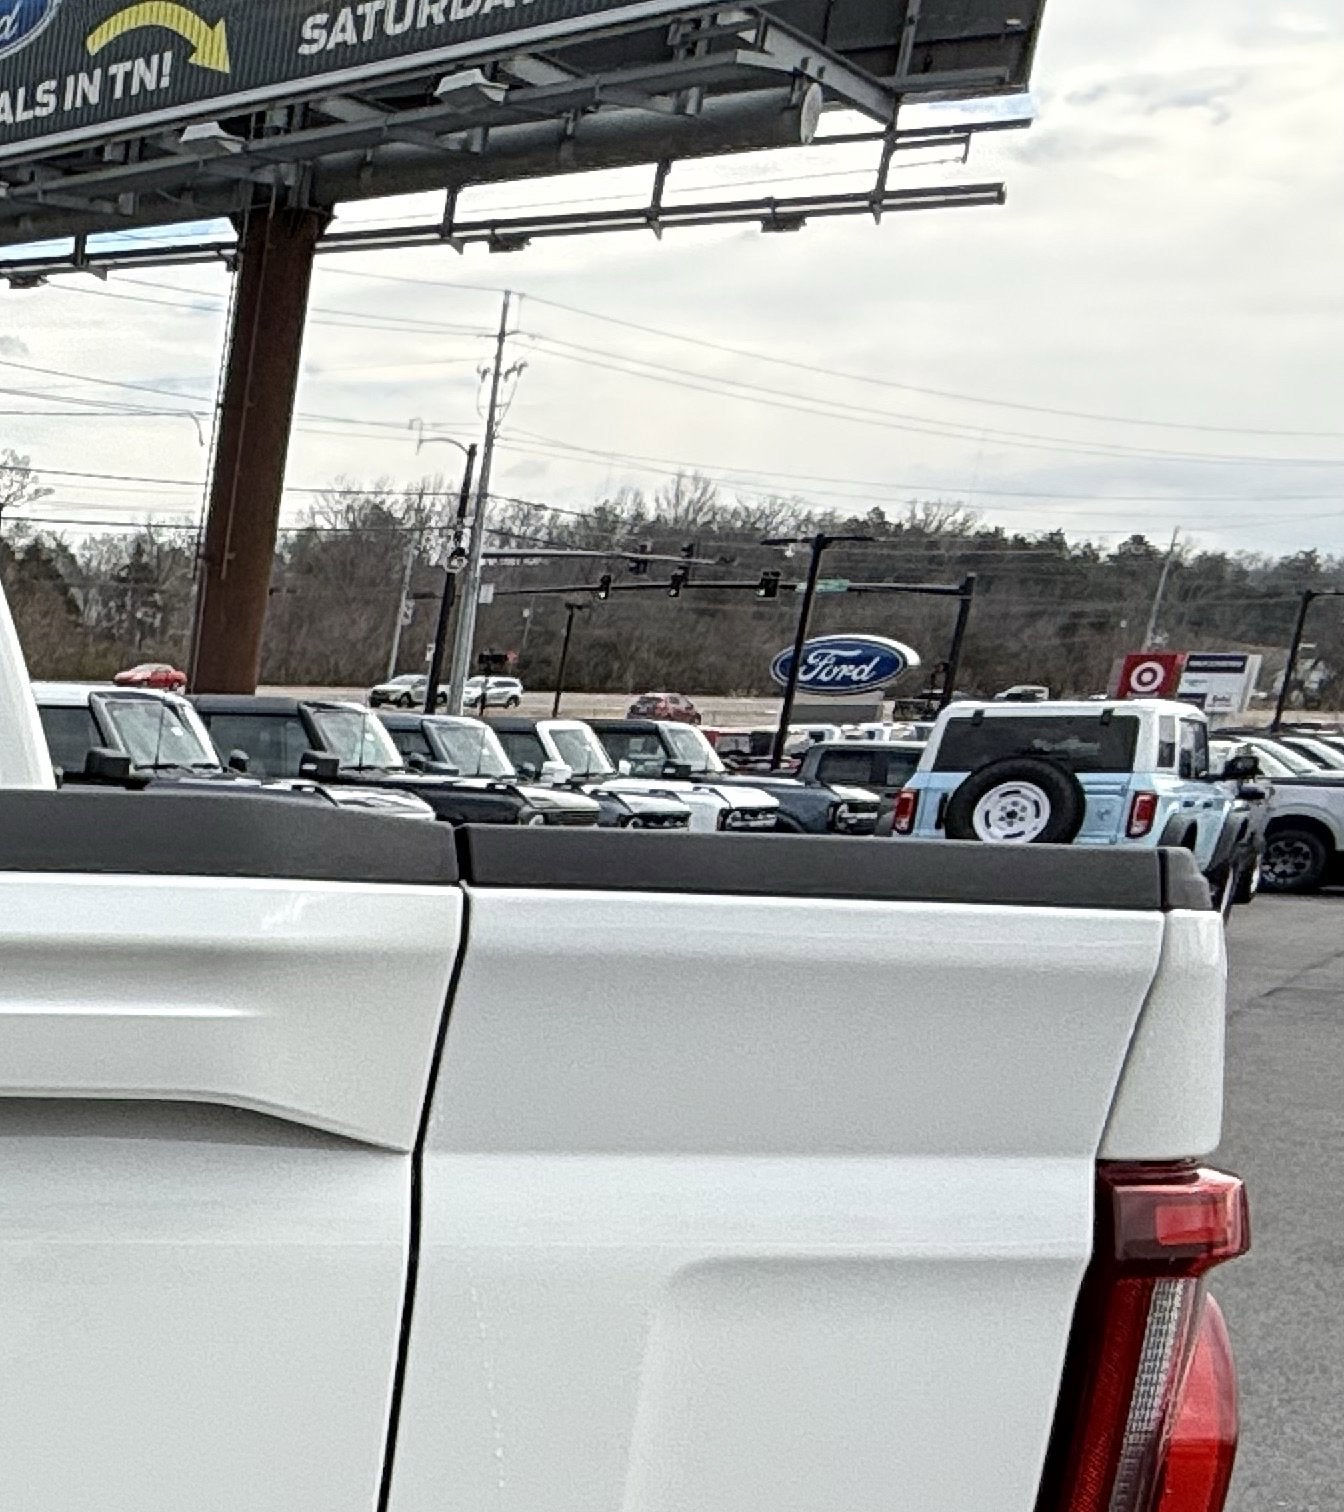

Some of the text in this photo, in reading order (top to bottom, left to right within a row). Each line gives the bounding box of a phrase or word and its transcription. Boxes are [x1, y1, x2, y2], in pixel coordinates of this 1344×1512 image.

[64, 69, 102, 110] IN
[108, 50, 174, 99] TN!
[798, 648, 880, 682] Ford
